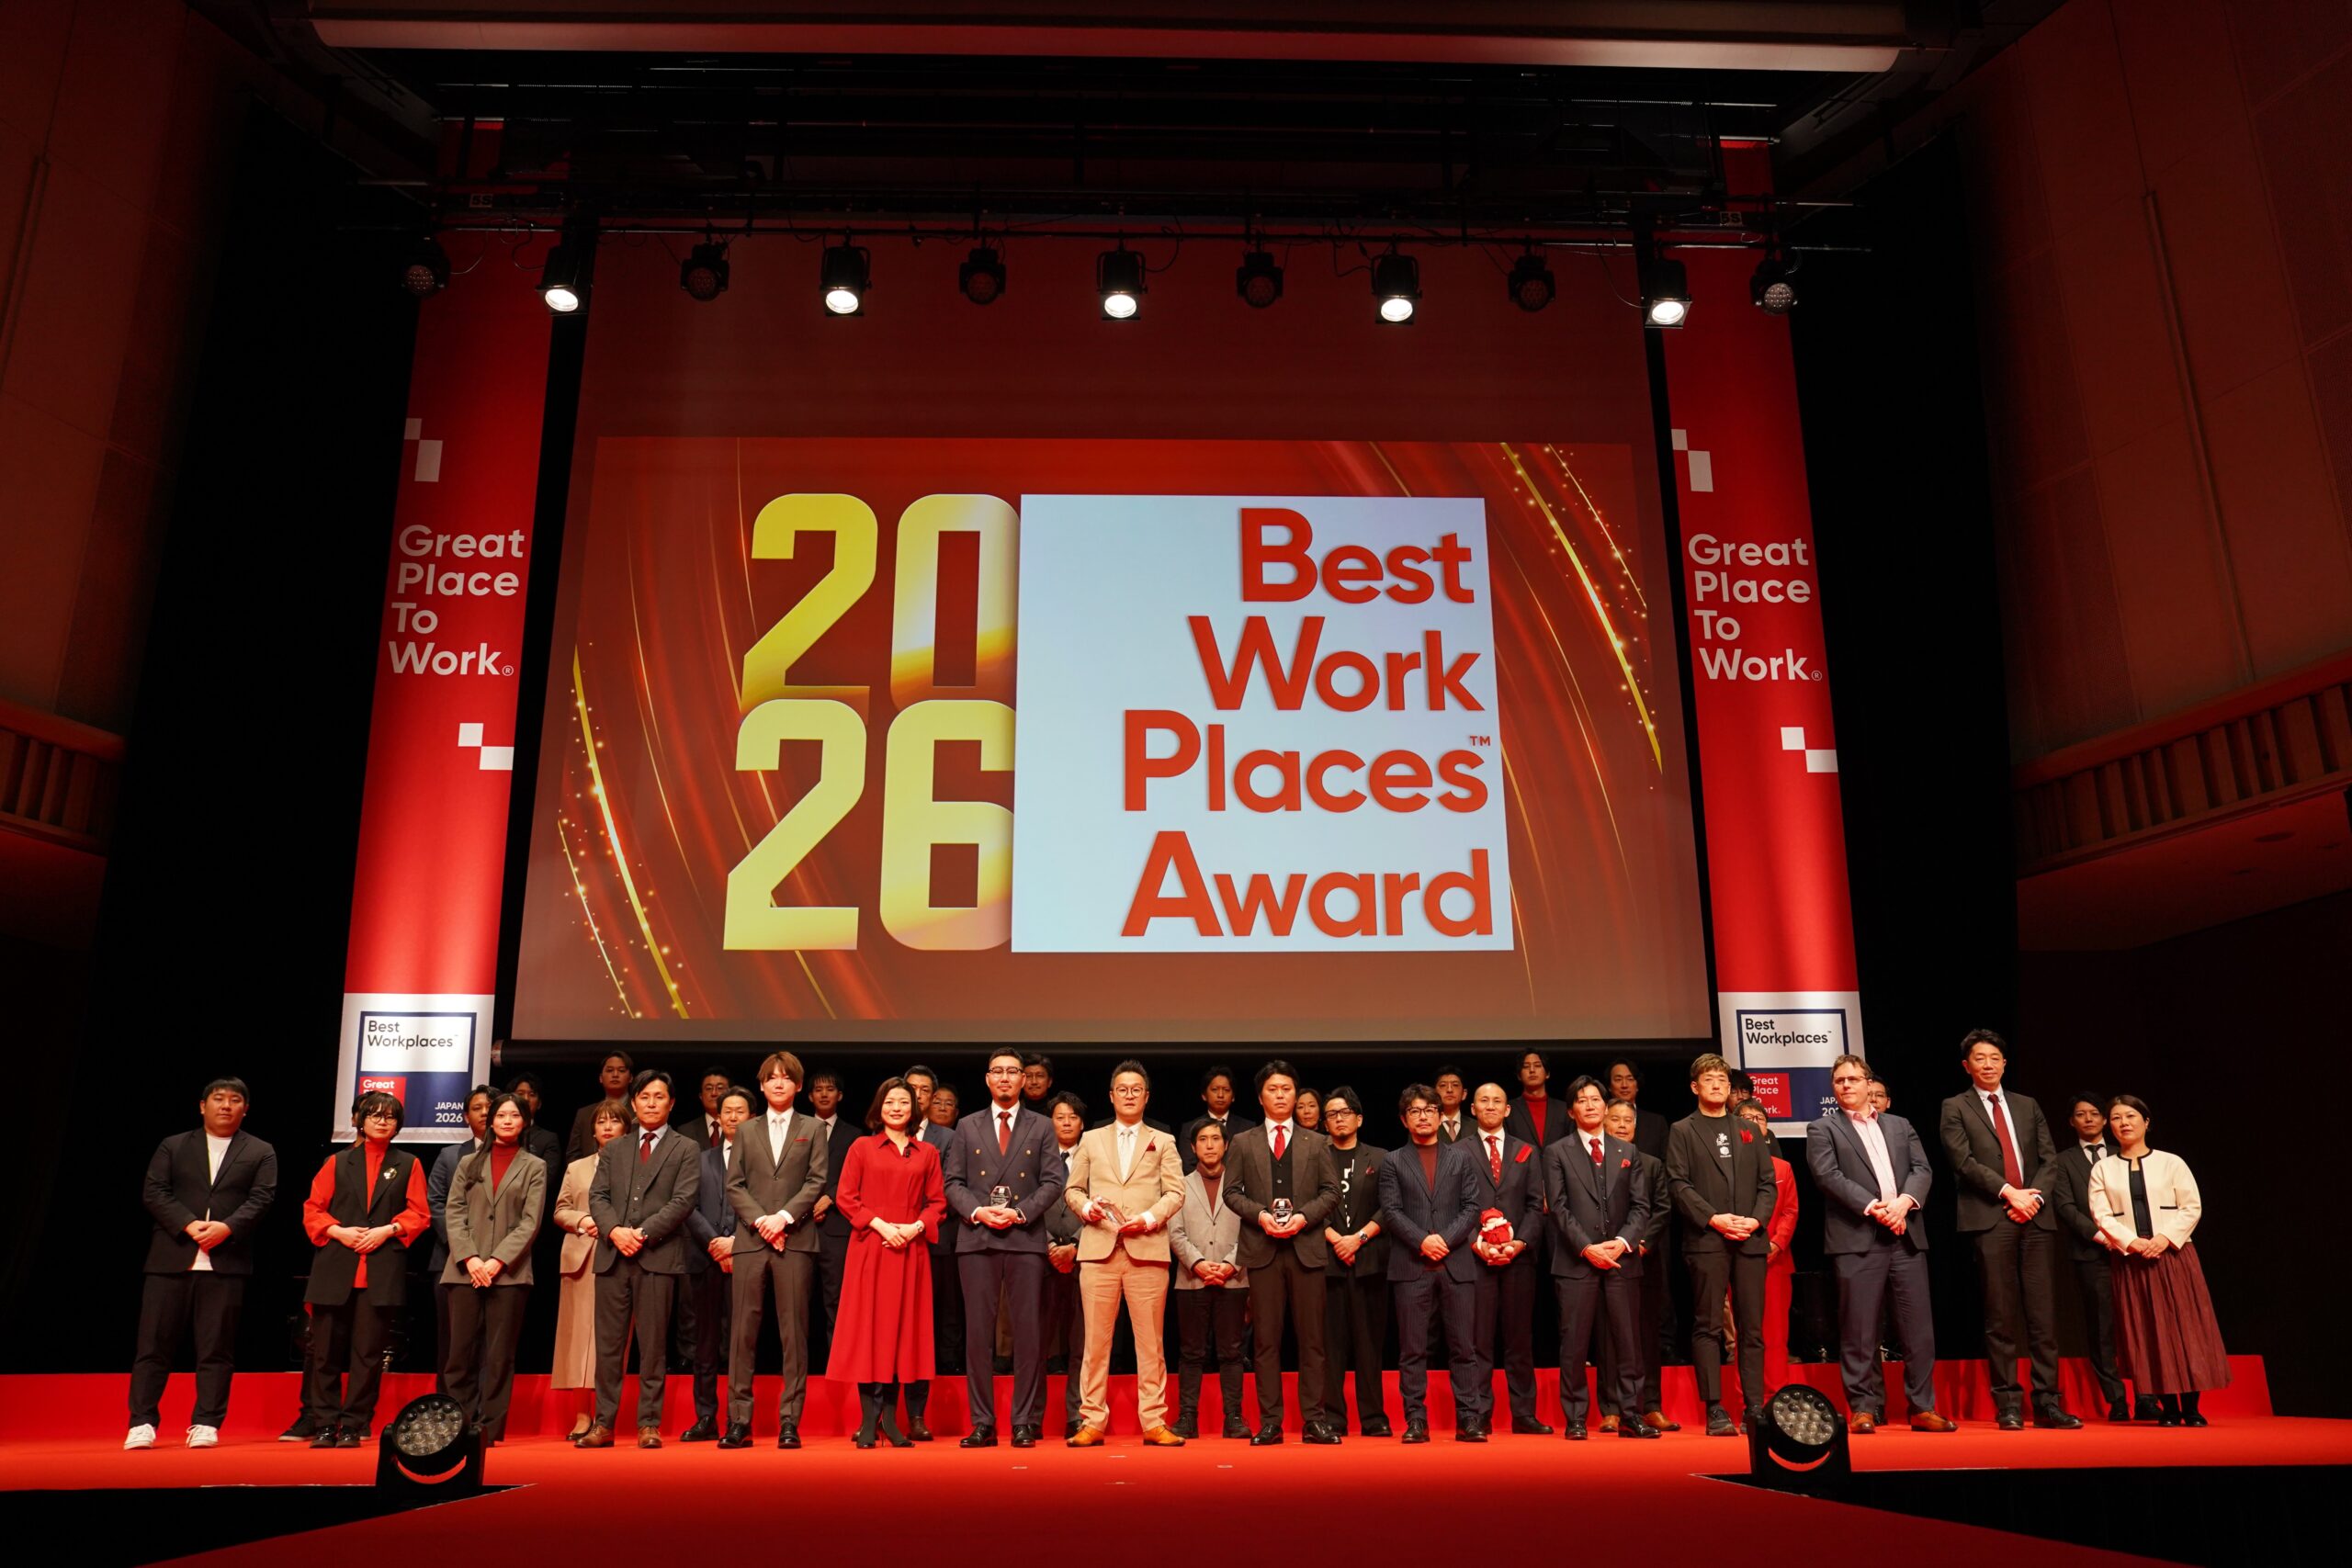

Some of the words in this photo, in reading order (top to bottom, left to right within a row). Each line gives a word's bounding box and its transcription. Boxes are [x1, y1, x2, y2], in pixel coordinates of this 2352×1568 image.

[399, 525, 525, 558] Great
[1238, 507, 1475, 604] Best
[1688, 534, 1809, 566] Great
[396, 562, 519, 596] Place
[1694, 570, 1811, 604] Place
[391, 602, 438, 634] To
[740, 493, 1021, 723] 20
[1693, 609, 1741, 640] To
[1188, 615, 1485, 713] Work
[723, 699, 1016, 950] 26
[1121, 830, 1494, 938] Award
[368, 1020, 401, 1032] Best
[1746, 1018, 1775, 1030] Best
[363, 1078, 395, 1089] Great
[435, 1101, 464, 1111] JAPAN
[1820, 1096, 1838, 1104] JAP
[1822, 1107, 1838, 1116] 20
[435, 1112, 464, 1123] 2026
